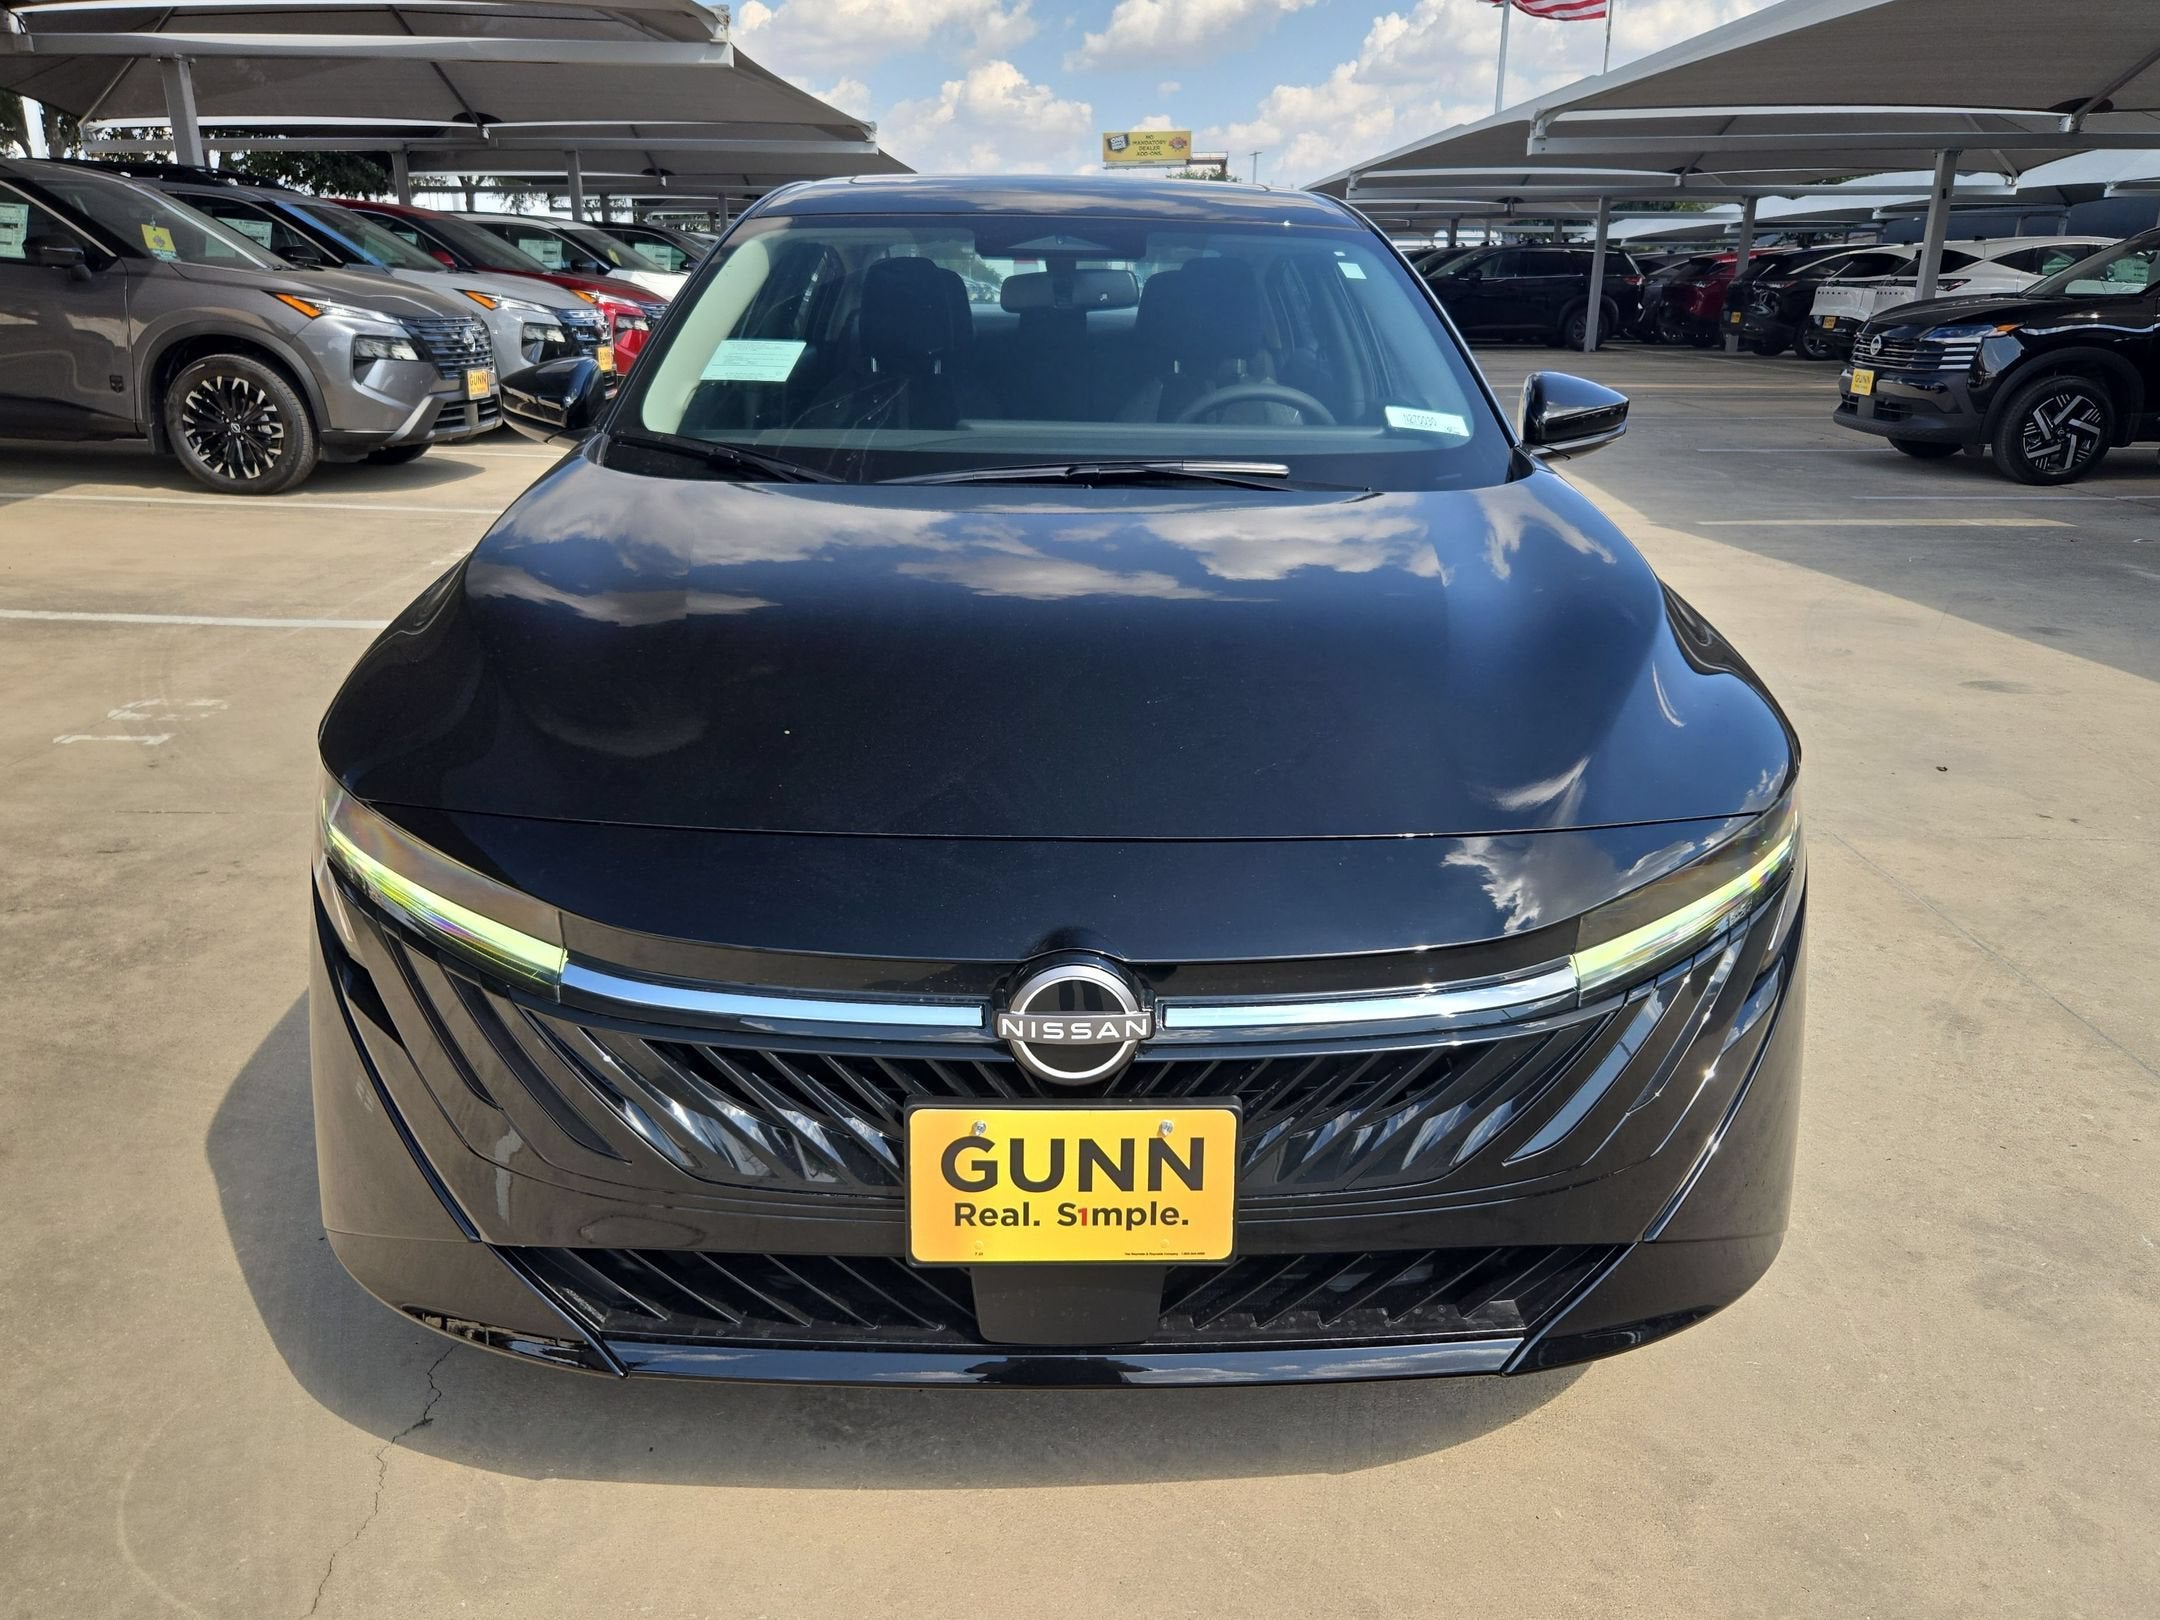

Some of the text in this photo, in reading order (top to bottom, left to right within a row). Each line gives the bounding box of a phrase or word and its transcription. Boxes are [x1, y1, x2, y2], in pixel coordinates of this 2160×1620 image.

[469, 372, 487, 386] GUNN
[1002, 1018, 1148, 1040] NISSAN
[941, 1136, 1204, 1193] GUNN
[954, 1201, 1189, 1231] Real. S1mple.
